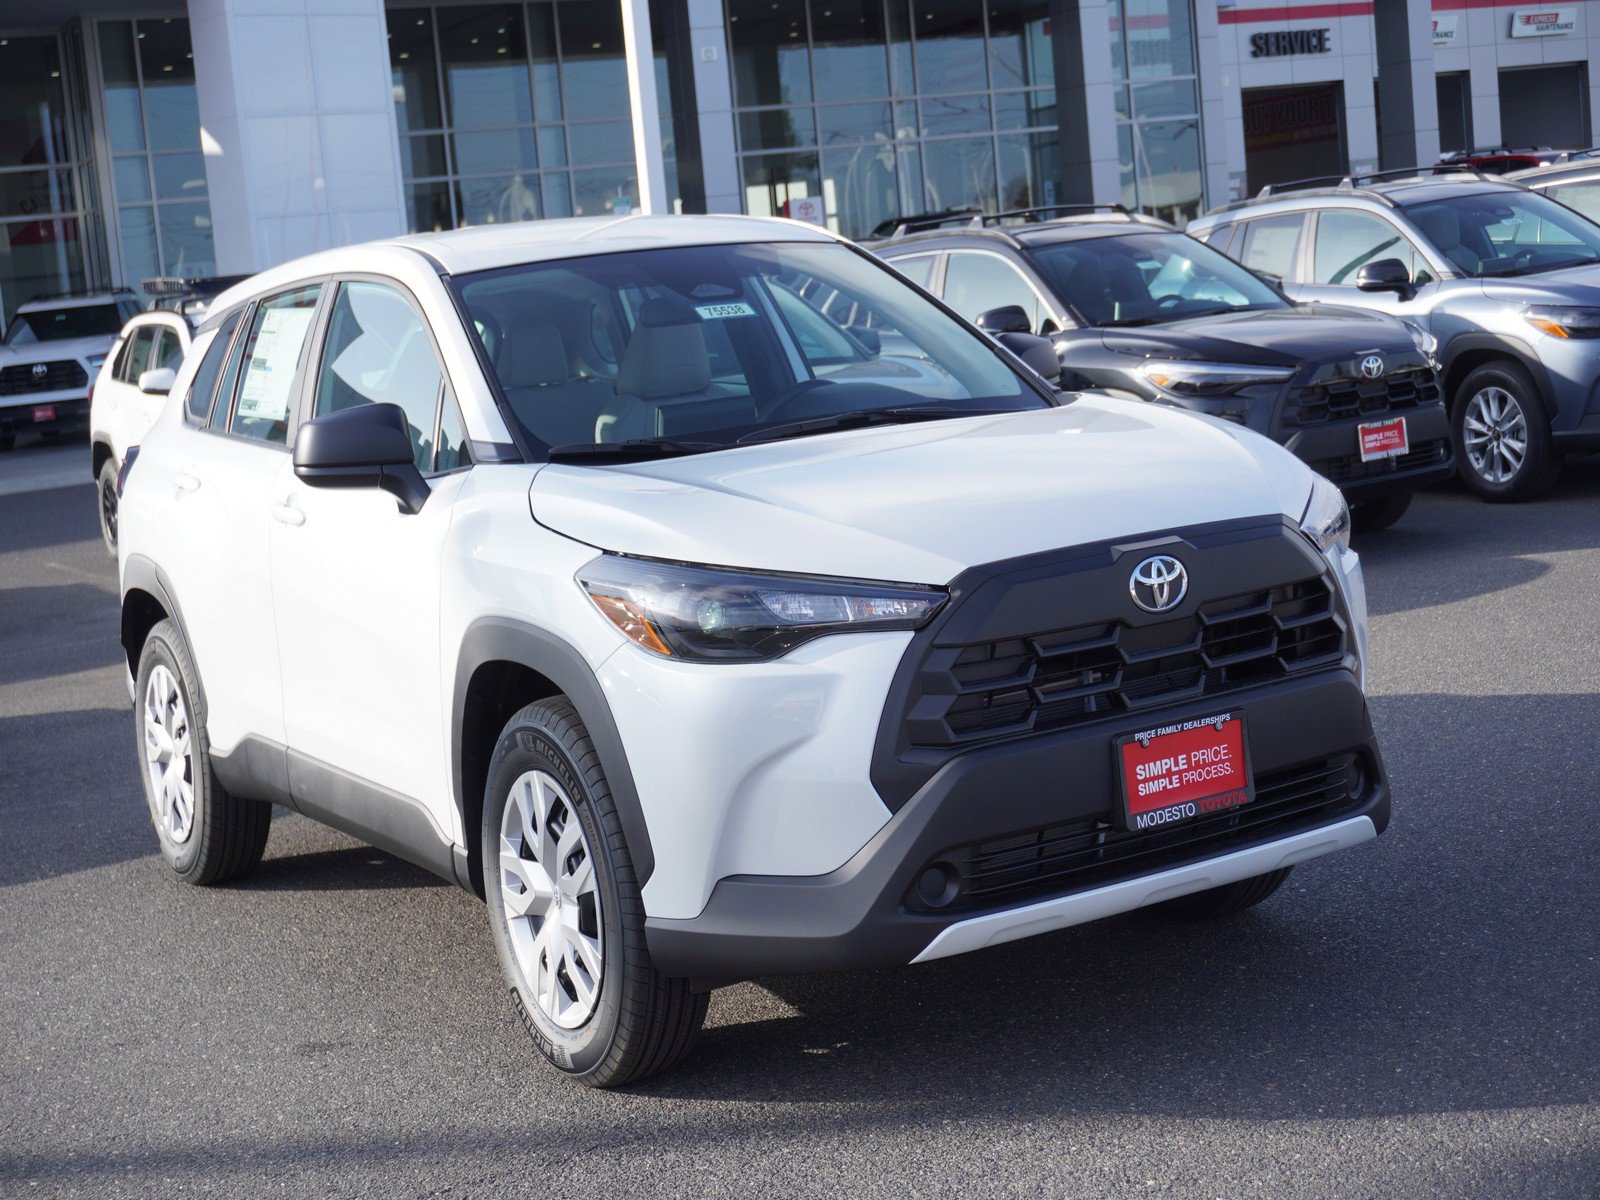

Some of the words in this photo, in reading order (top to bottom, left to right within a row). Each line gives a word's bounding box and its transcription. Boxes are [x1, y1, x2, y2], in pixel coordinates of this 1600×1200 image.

[1529, 14, 1557, 24] EXPRESS
[1536, 22, 1574, 32] MAINTENANCE
[1251, 28, 1331, 58] SERVICE
[1274, 95, 1320, 129] YOUR
[704, 305, 746, 317] 75538
[1364, 432, 1383, 442] SIMPLE
[1365, 440, 1380, 448] SIMPLE
[1134, 730, 1156, 742] PRICE
[1157, 724, 1182, 737] FAMILY
[1184, 713, 1230, 730] DEALERSHIPS
[536, 739, 586, 807] MICHELIN
[1135, 754, 1188, 781] SIMPLE
[1191, 744, 1232, 767] PRICE.
[1137, 774, 1181, 797] SIMPLE
[1182, 762, 1234, 785] PROCESS.
[1136, 802, 1196, 829] MODESTO
[1197, 790, 1247, 813] TOYOTA
[510, 986, 555, 1057] MICHELIN
